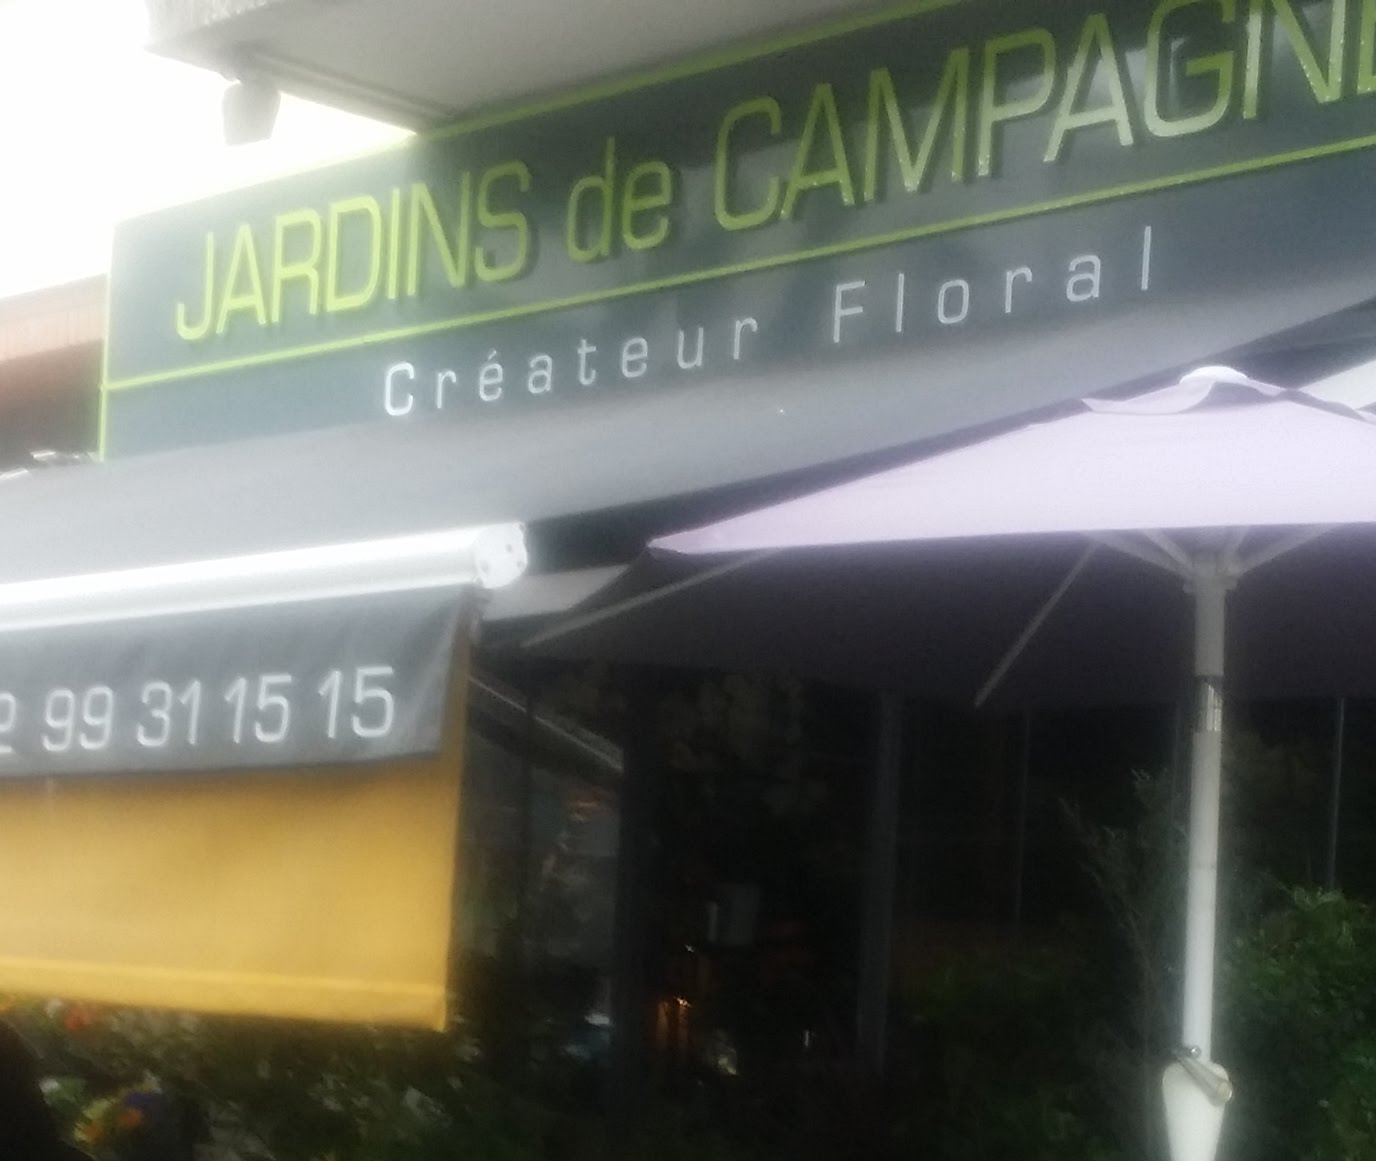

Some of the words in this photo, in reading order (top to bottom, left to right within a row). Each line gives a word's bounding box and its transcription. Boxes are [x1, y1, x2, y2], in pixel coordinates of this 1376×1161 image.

[177, 159, 530, 341] JARDINS
[565, 136, 672, 262] de
[383, 315, 758, 417] Créateur
[832, 225, 1153, 343] Floral
[42, 686, 114, 753] 99
[135, 680, 201, 748] 31
[224, 673, 292, 745] 15
[318, 665, 395, 740] 15
